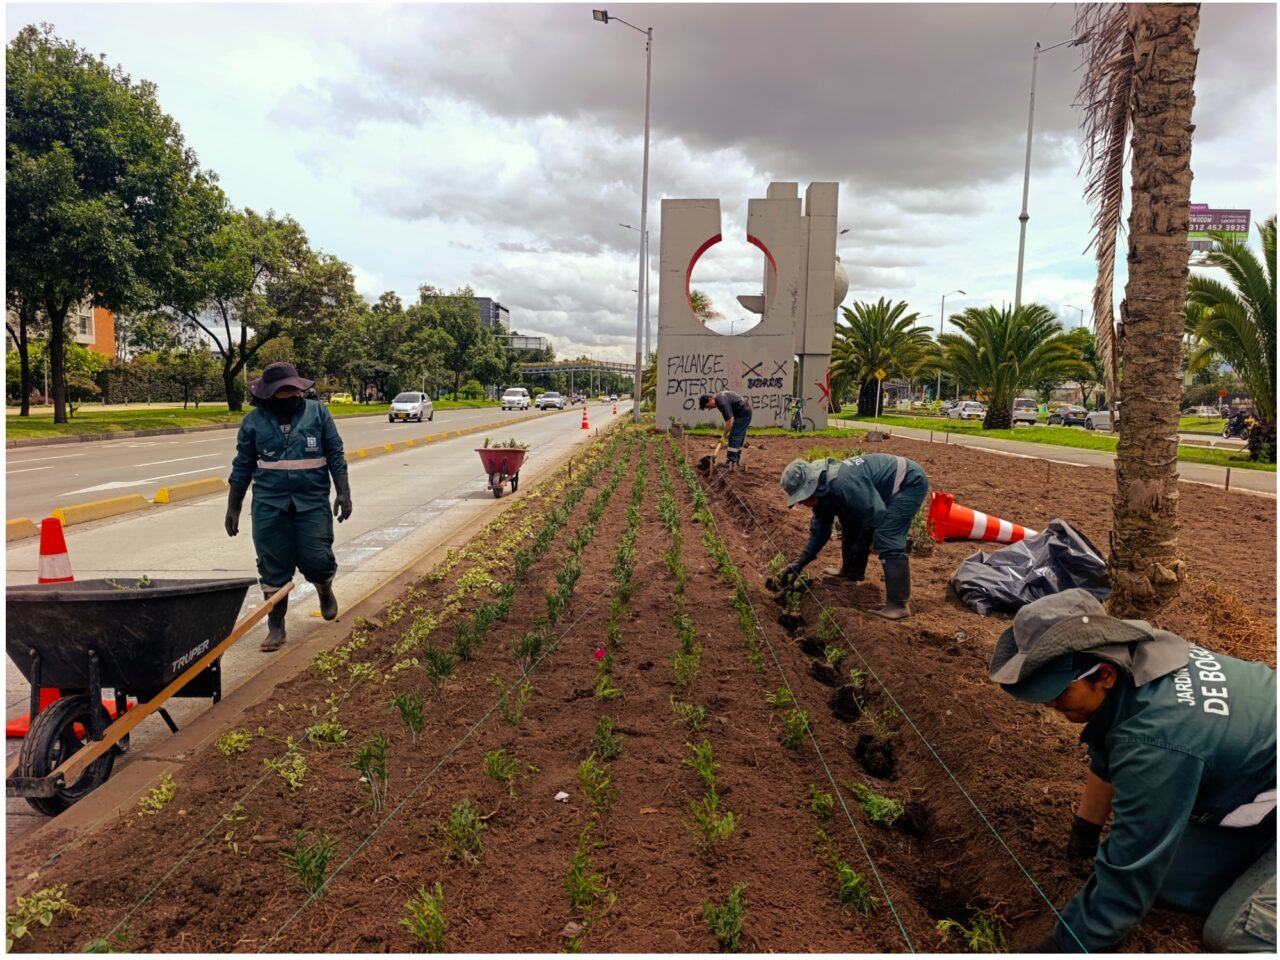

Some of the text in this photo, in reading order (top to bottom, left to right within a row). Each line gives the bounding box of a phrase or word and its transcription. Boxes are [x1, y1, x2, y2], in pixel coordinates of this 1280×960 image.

[667, 353, 724, 376] FALANGE
[666, 377, 731, 398] EXTERIOR
[171, 638, 210, 673] TRUPER
[1200, 686, 1230, 716] DE
